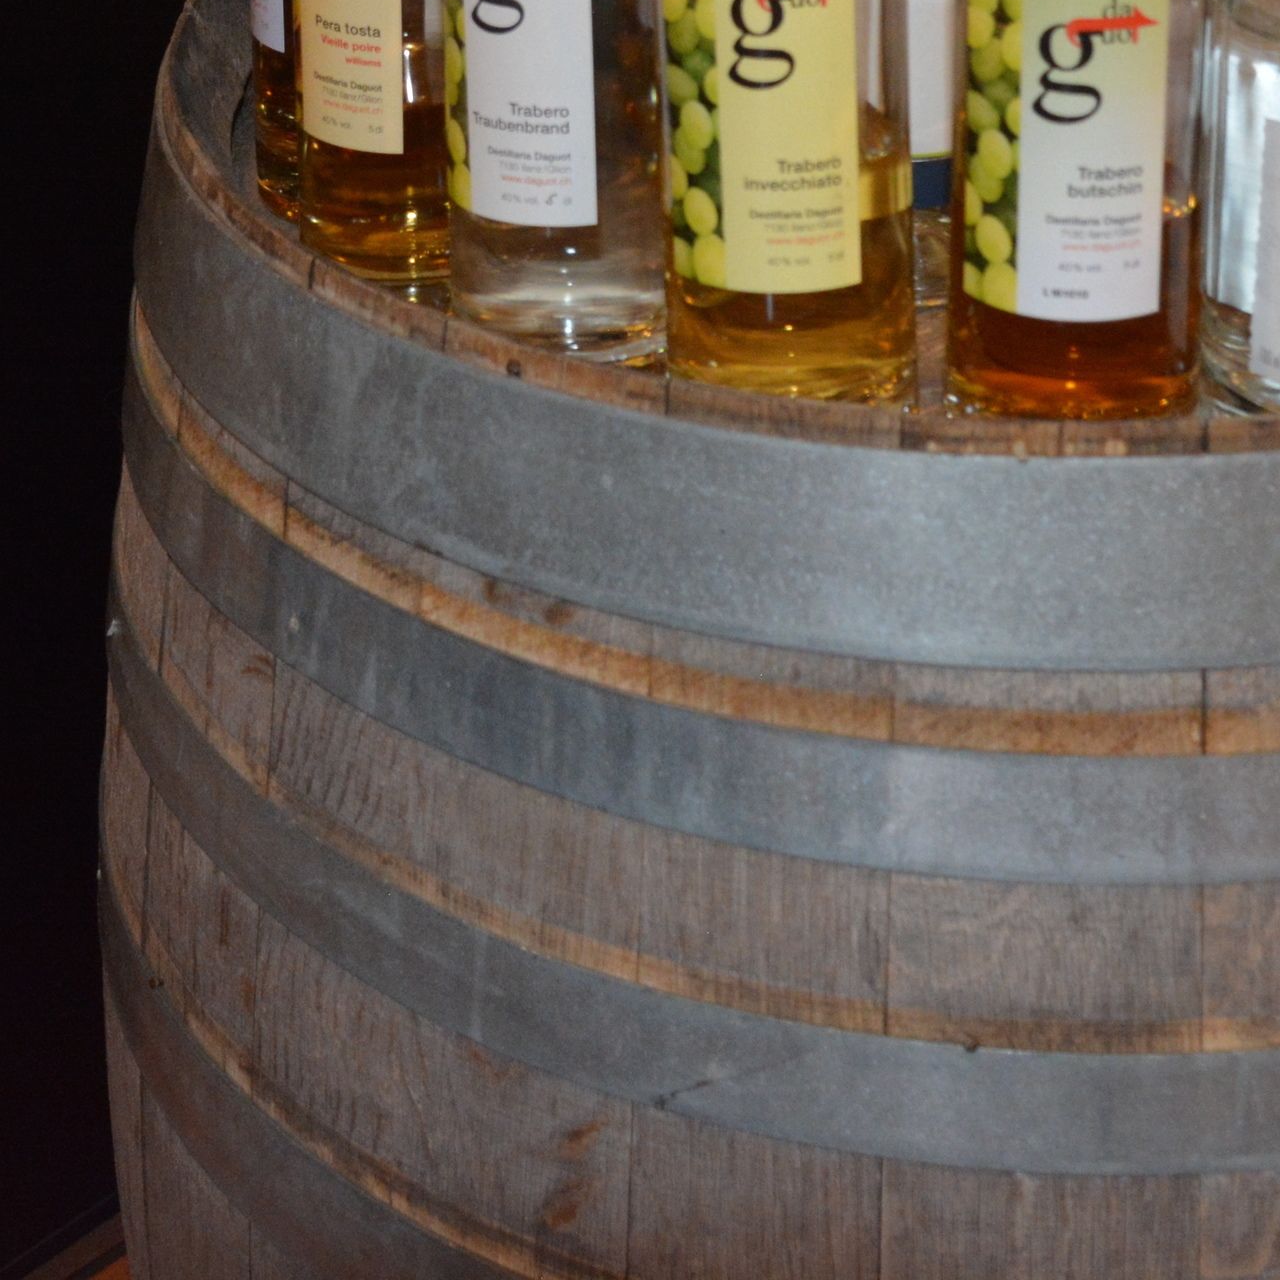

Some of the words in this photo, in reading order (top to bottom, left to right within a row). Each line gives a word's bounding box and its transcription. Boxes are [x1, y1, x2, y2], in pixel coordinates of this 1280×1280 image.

[315, 14, 341, 33] Pera
[345, 23, 381, 38] tosta
[510, 102, 570, 118] Trabero
[473, 111, 570, 134] Traubenbrand
[777, 156, 841, 174] Trabero
[1079, 166, 1143, 180] Trabero
